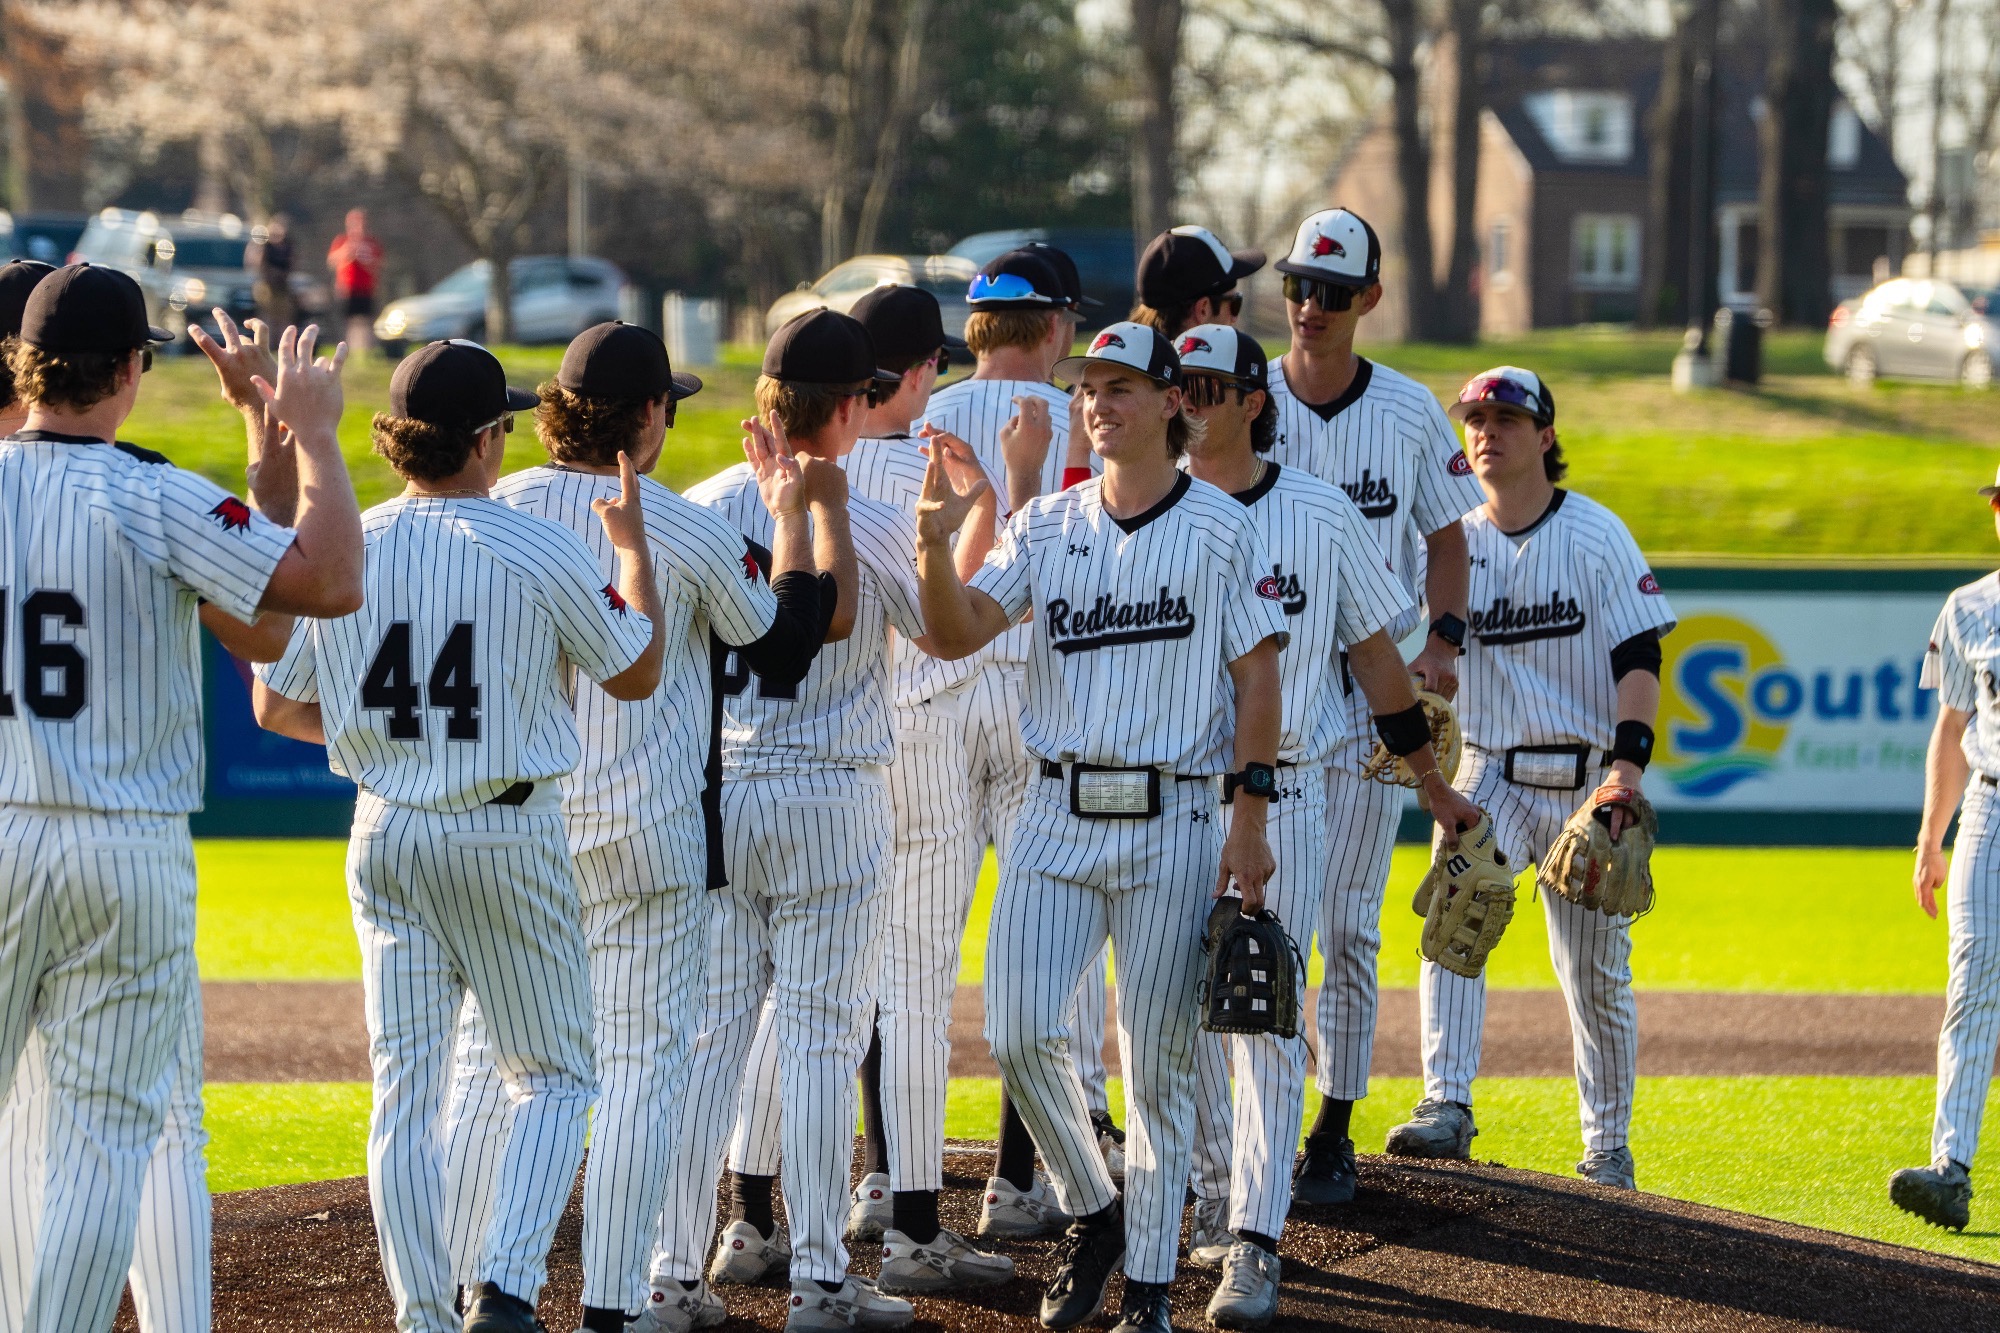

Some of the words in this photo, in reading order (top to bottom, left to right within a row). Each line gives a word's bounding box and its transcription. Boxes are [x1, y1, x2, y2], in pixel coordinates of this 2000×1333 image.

[1046, 585, 1190, 639] Redhawks
[1468, 590, 1580, 633] edhawks
[360, 619, 483, 743] 44
